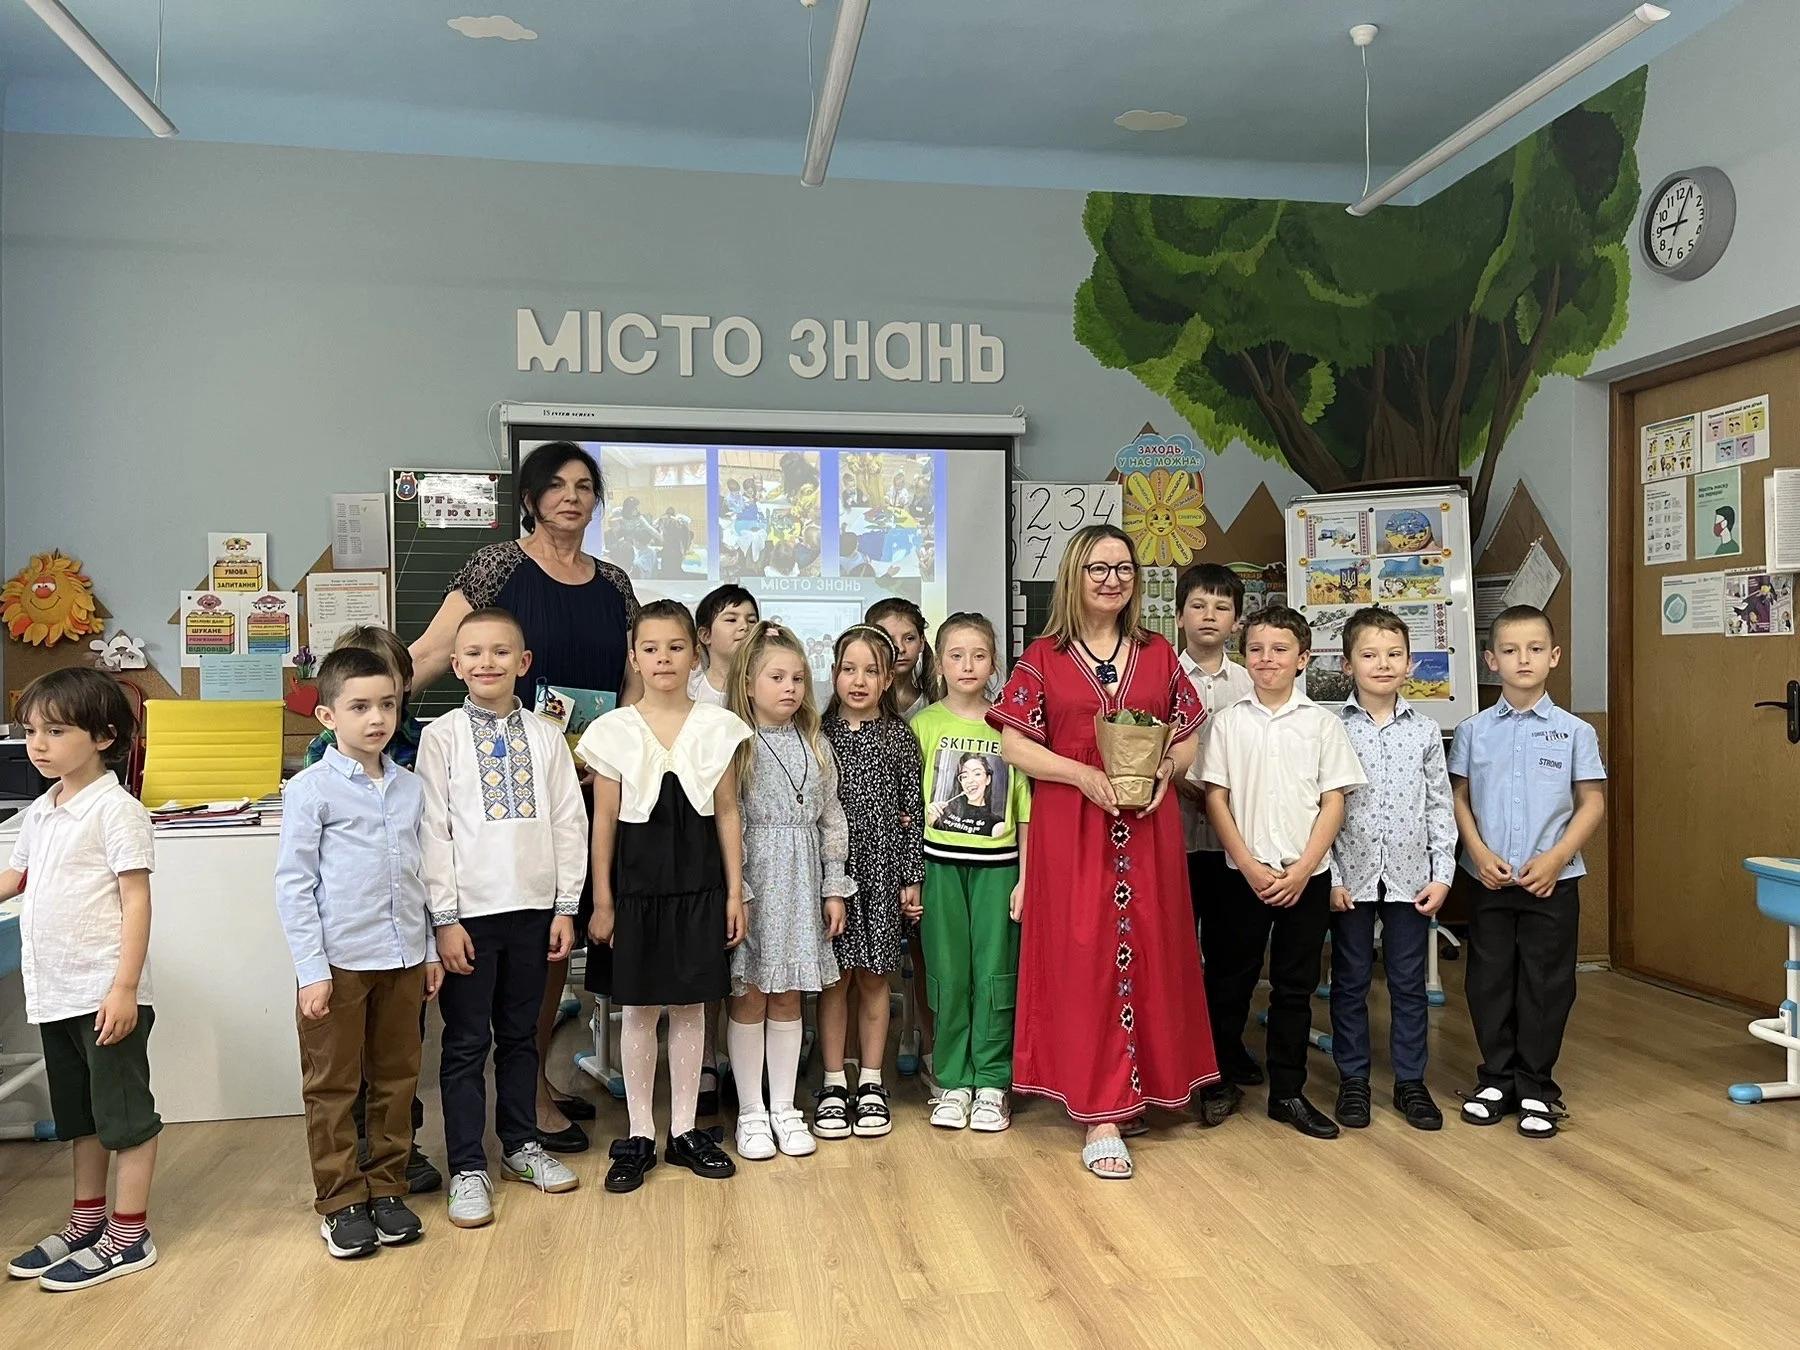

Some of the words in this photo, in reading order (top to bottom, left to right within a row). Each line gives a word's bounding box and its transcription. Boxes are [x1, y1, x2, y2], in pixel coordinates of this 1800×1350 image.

[1677, 188, 1685, 200] 12
[1667, 196, 1674, 208] 11
[1696, 195, 1702, 207] 2
[1659, 210, 1667, 223] 10
[1699, 208, 1704, 220] 3
[1657, 227, 1662, 238] 9
[1696, 225, 1702, 234] 4
[1660, 240, 1666, 251] 8
[1688, 239, 1694, 251] 5
[1667, 248, 1673, 260] 7
[1677, 247, 1683, 259] 6
[516, 307, 763, 378] МІСТО
[1138, 445, 1184, 455] ЗАХОДЬ,
[1119, 458, 1126, 467] У
[1129, 457, 1152, 467] НАС
[1154, 457, 1200, 466] МОЖНА:
[1027, 487, 1051, 530] 2
[1058, 487, 1085, 531] 3
[1093, 489, 1115, 525] 4
[1027, 536, 1052, 578] 7
[761, 579, 811, 590] МІСТО
[940, 737, 1002, 754] SKITTIE
[1539, 758, 1562, 769] STRONG
